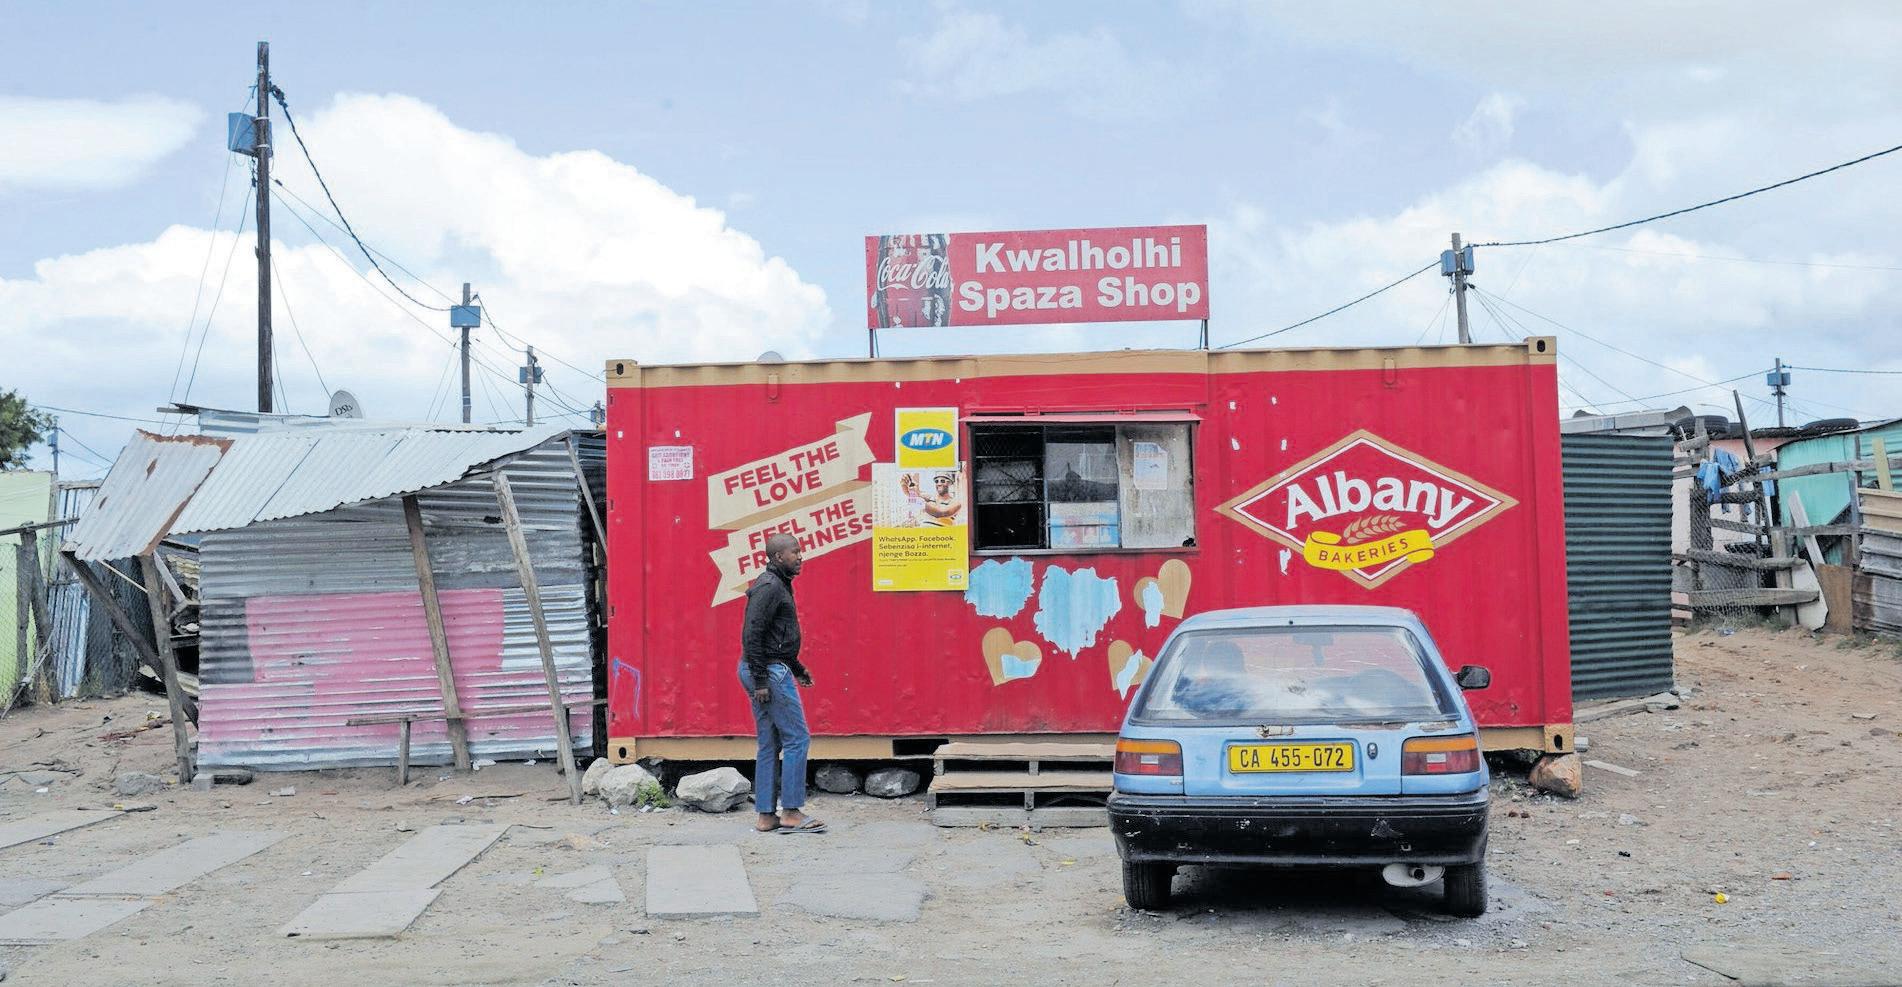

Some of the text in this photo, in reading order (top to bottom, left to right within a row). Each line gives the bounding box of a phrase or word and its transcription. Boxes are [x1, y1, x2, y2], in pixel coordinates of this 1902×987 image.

[877, 255, 950, 291] Coca-Cola
[976, 237, 1181, 273] Kwalholhi
[959, 276, 1200, 318] Spaza Shop
[909, 432, 944, 447] MTN
[724, 441, 840, 496] FEEL THE
[753, 469, 823, 508] LOVE
[1286, 471, 1474, 530] Albany
[809, 498, 856, 526] THE
[737, 513, 873, 576] FRHNESS
[1318, 538, 1409, 564] BAKERIES
[1240, 747, 1344, 768] CA 455-072
